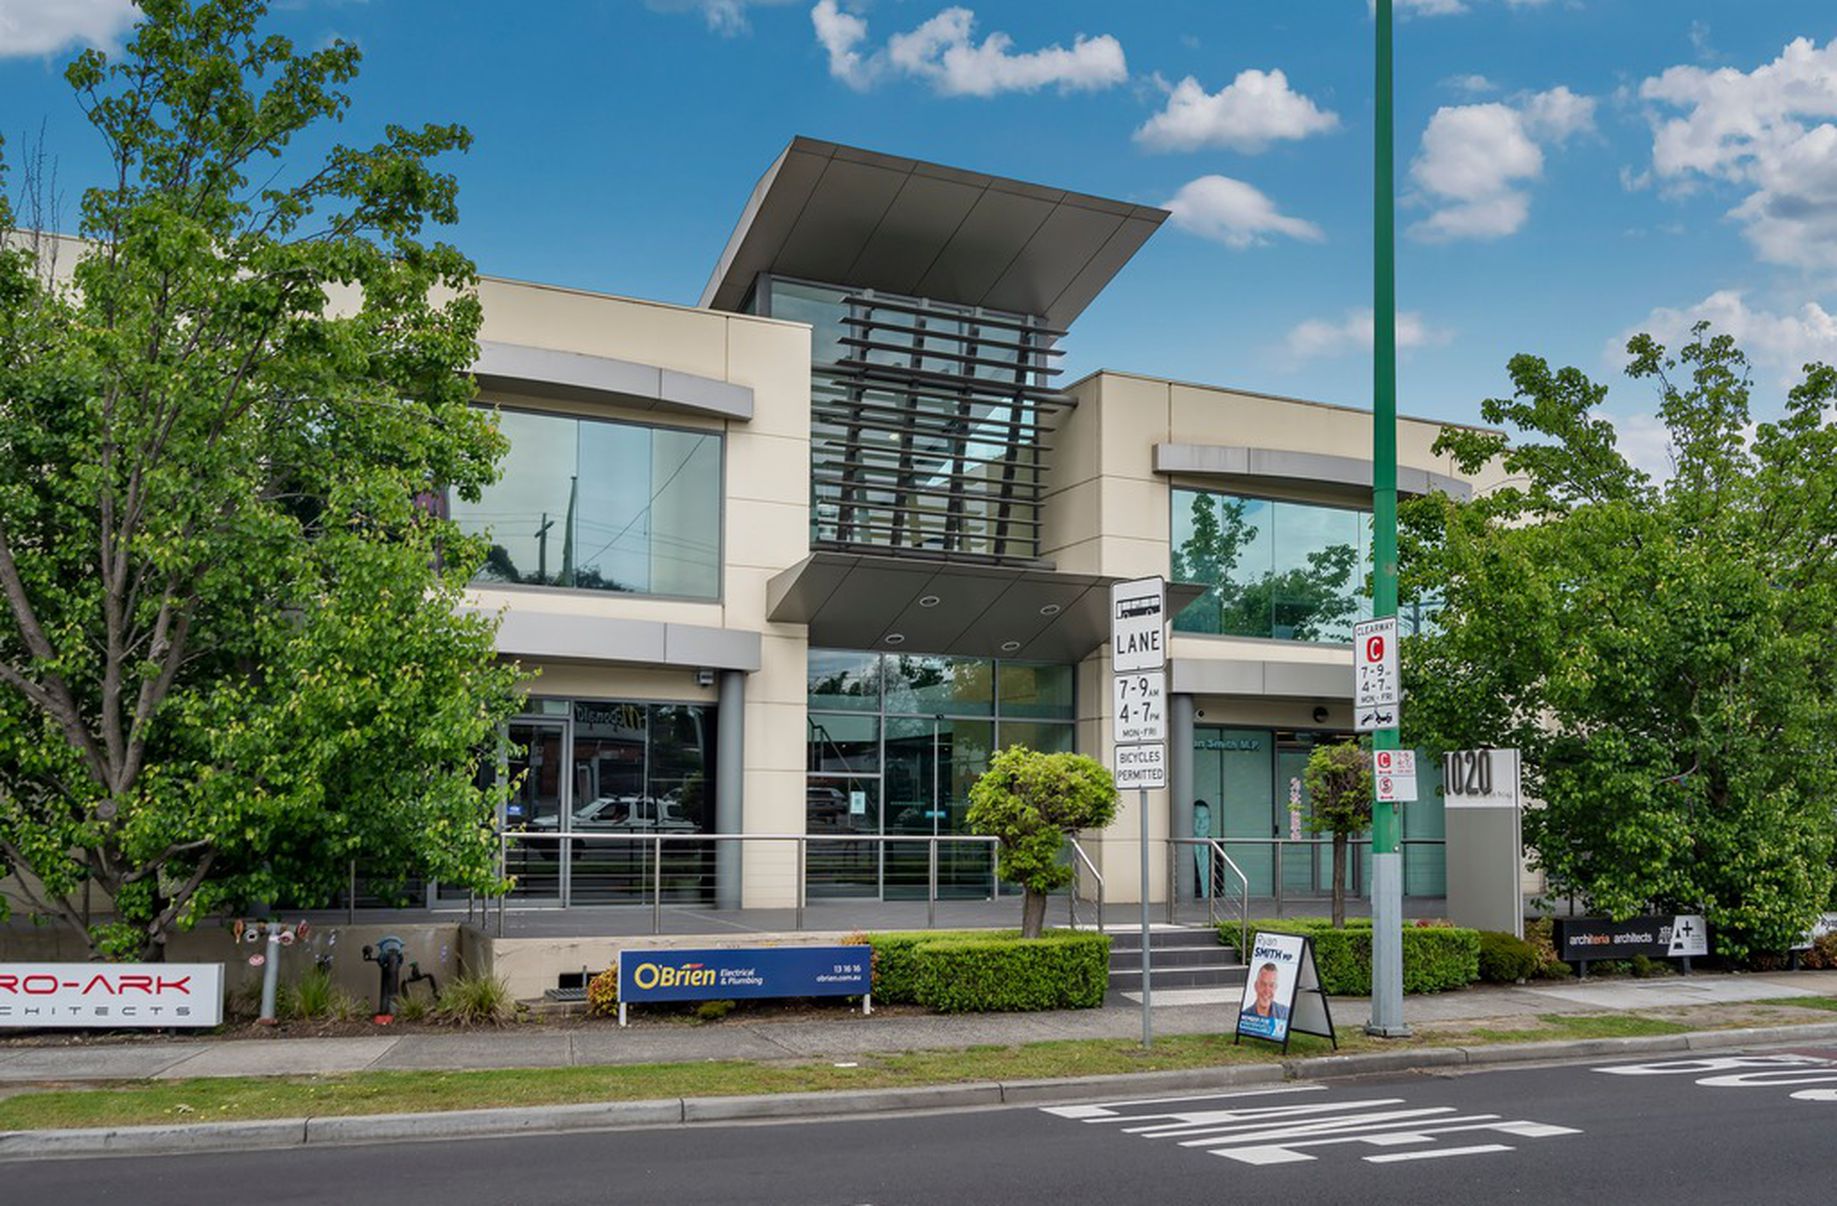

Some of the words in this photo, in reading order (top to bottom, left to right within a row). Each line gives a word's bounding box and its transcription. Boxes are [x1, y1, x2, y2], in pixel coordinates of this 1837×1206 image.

[1357, 622, 1394, 636] CLEARWAY
[1117, 631, 1160, 655] LANE
[1119, 751, 1161, 764] BICYCLES
[1117, 768, 1163, 780] PERMITTED
[1443, 751, 1492, 795] 1020
[1613, 931, 1653, 944] architects
[1255, 947, 1282, 959] SMITH
[720, 968, 755, 977] Electrical
[834, 965, 842, 973] 13
[728, 976, 763, 987] Plumbing
